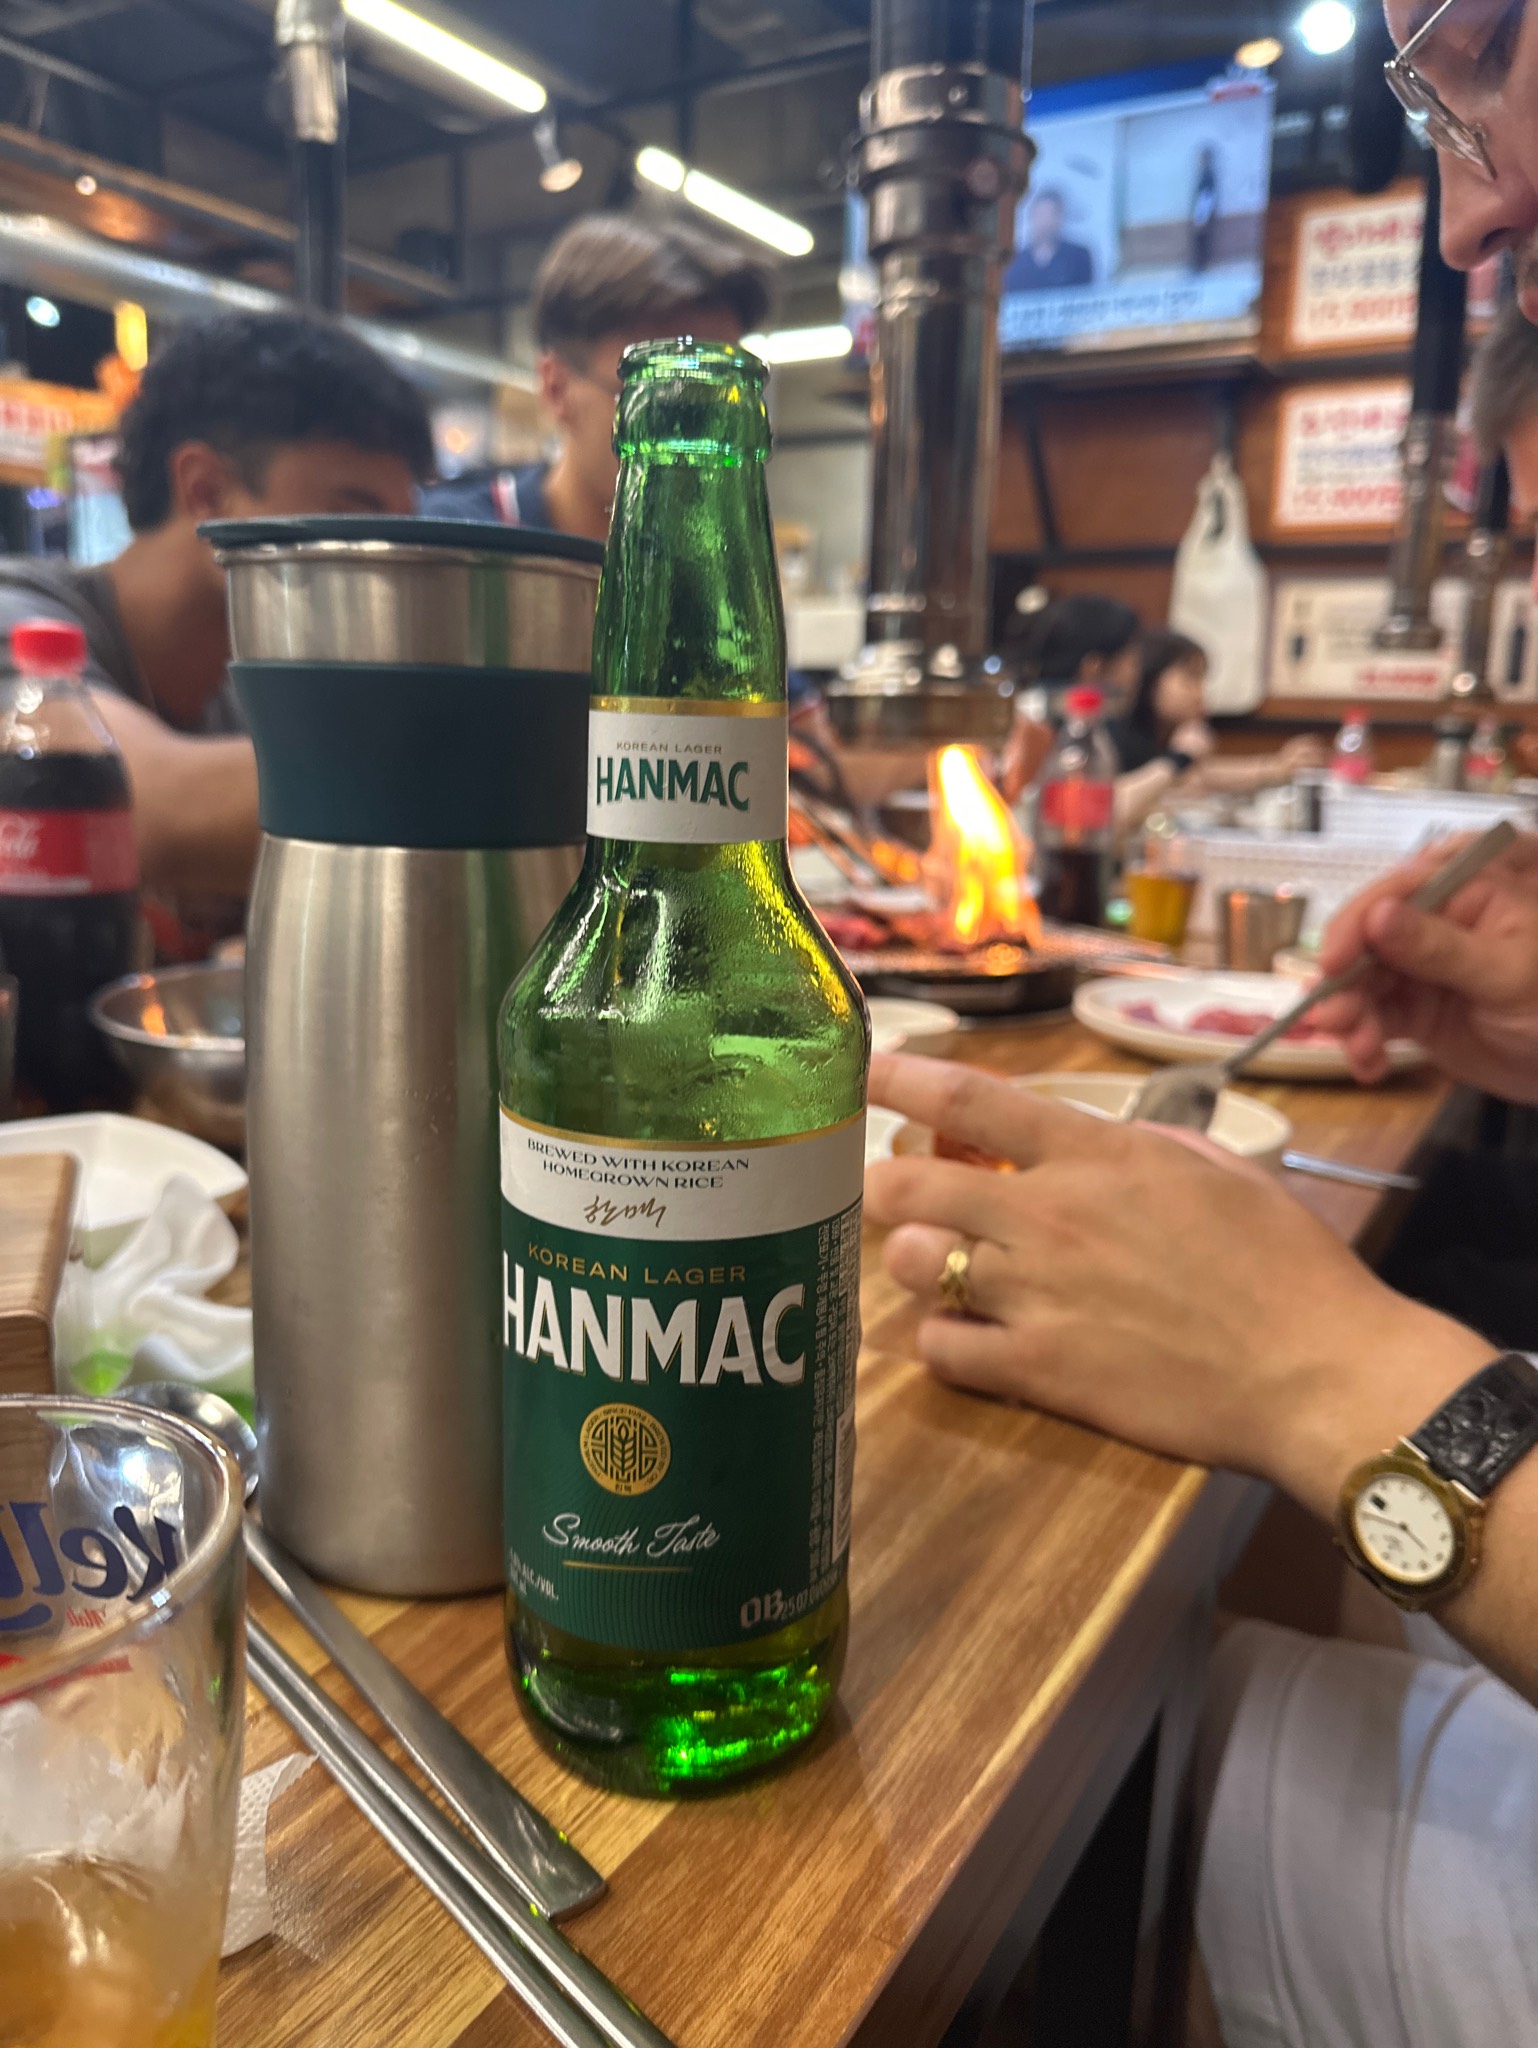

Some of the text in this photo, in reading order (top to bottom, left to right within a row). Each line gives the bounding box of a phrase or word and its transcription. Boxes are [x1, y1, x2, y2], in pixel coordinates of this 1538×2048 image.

[616, 741, 722, 755] KOREAN LAGER
[596, 756, 750, 812] HANMAC
[527, 1138, 750, 1172] BREWED WITH KOREAN
[543, 1160, 724, 1189] HOMEGROWN RICE
[528, 1242, 747, 1285] KOREAN LAGER
[503, 1250, 806, 1386] HANMAC
[542, 1512, 722, 1558] Smooth Taste
